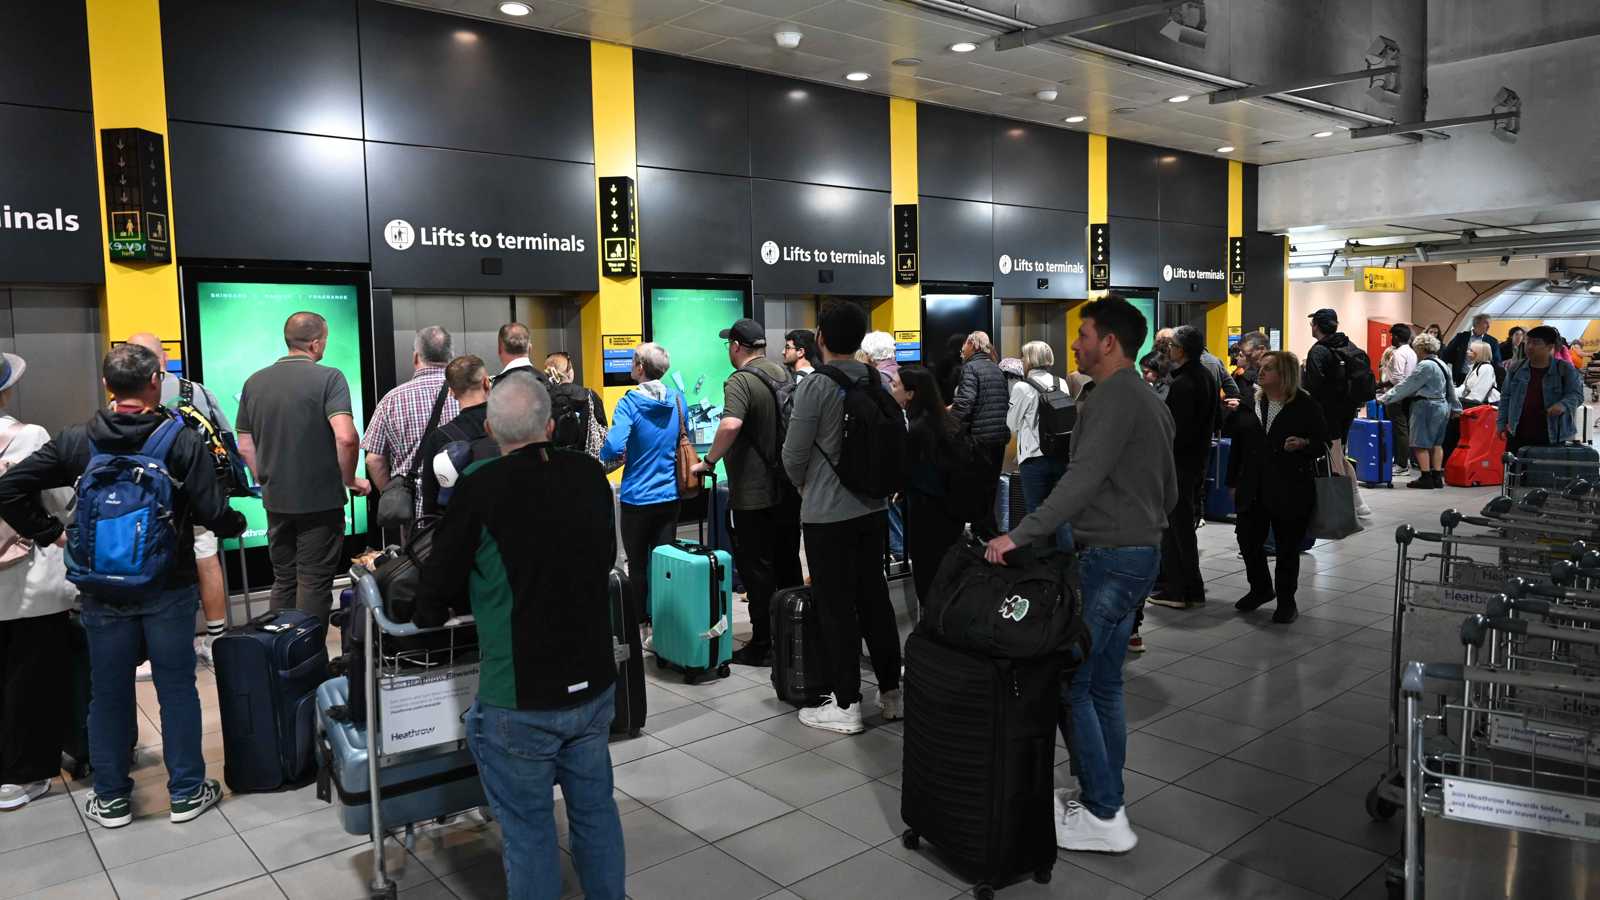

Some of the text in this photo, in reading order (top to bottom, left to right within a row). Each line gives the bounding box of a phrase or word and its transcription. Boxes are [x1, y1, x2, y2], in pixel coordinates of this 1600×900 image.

[0, 205, 80, 232] inals
[420, 226, 586, 253] Lifts to terminals
[783, 246, 886, 266] Lifts to terminals
[1013, 258, 1084, 274] Lifts to terminals
[1173, 267, 1225, 280] Lifts to terminals
[391, 726, 436, 742] Heathrow
[1506, 798, 1539, 810] Rewards
[1495, 807, 1513, 816] your
[1514, 810, 1537, 819] travel
